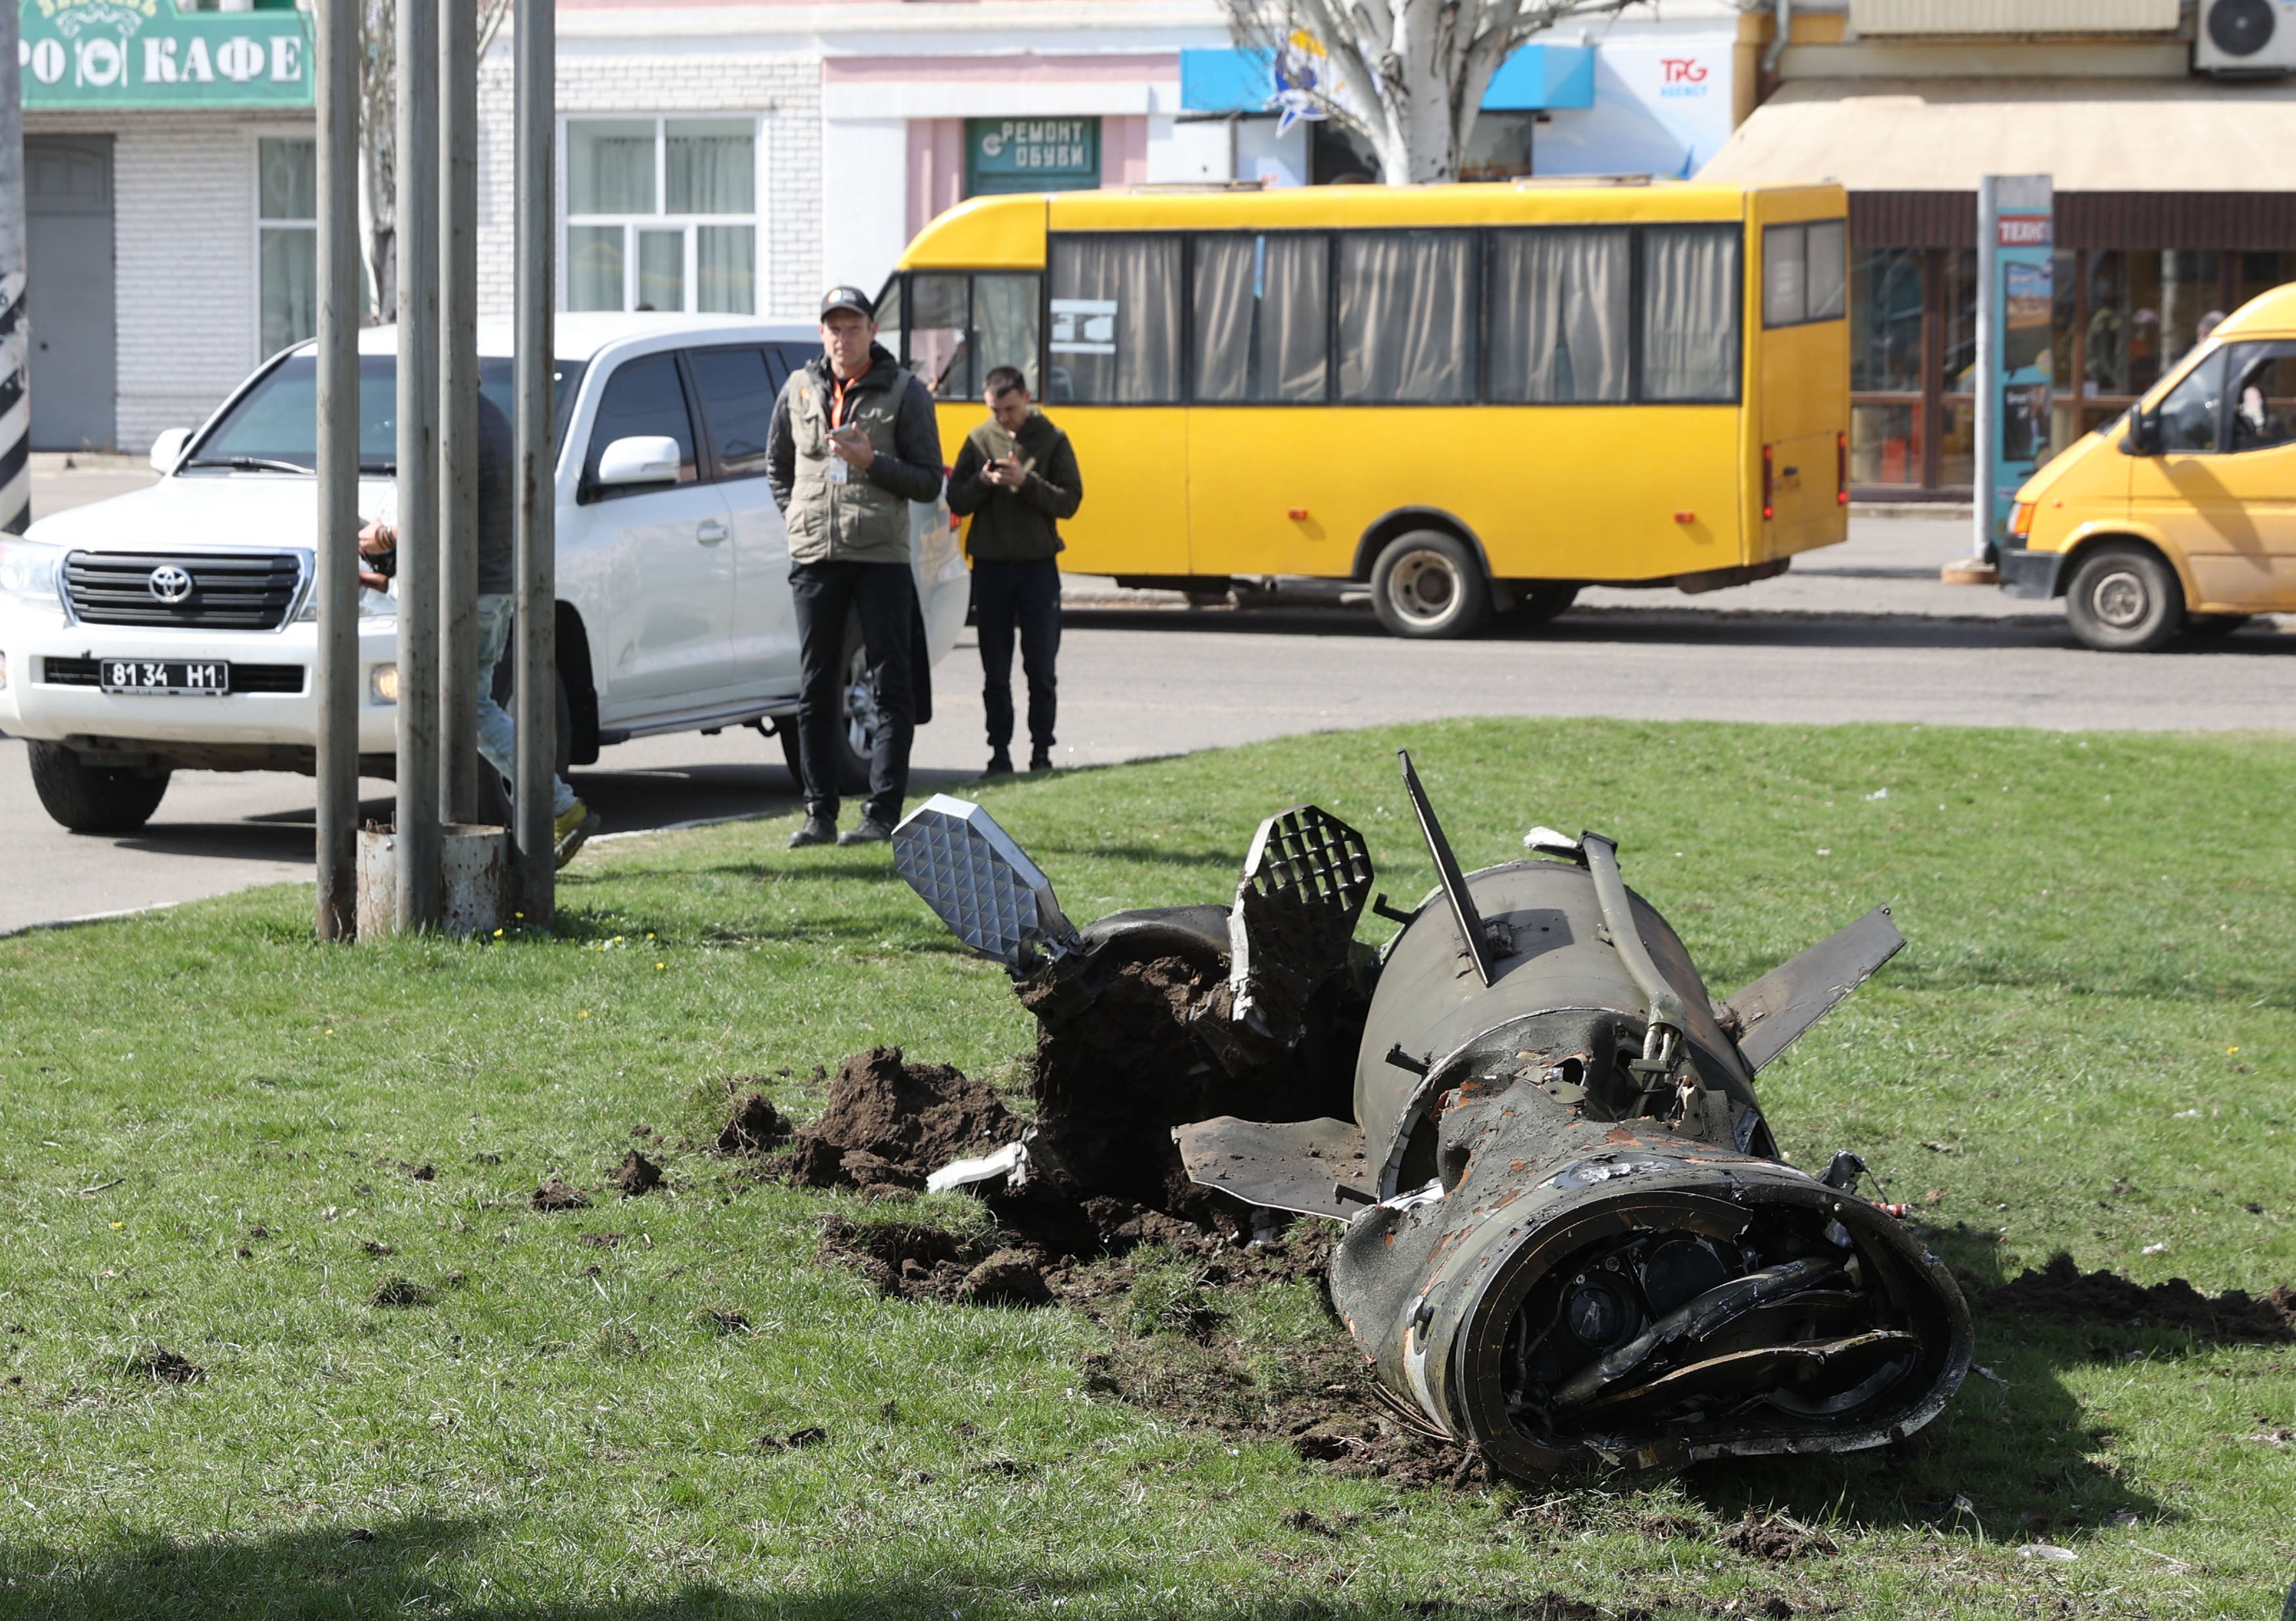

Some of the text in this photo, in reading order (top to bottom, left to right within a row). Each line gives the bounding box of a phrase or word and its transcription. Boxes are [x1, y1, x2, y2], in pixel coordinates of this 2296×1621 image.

[142, 35, 302, 83] КАФЕ
[1660, 58, 1708, 83] TPG
[1002, 121, 1082, 144] РЕМОНТ
[1015, 145, 1084, 167] ОБУВИ
[113, 663, 216, 687] 81 34 H1
